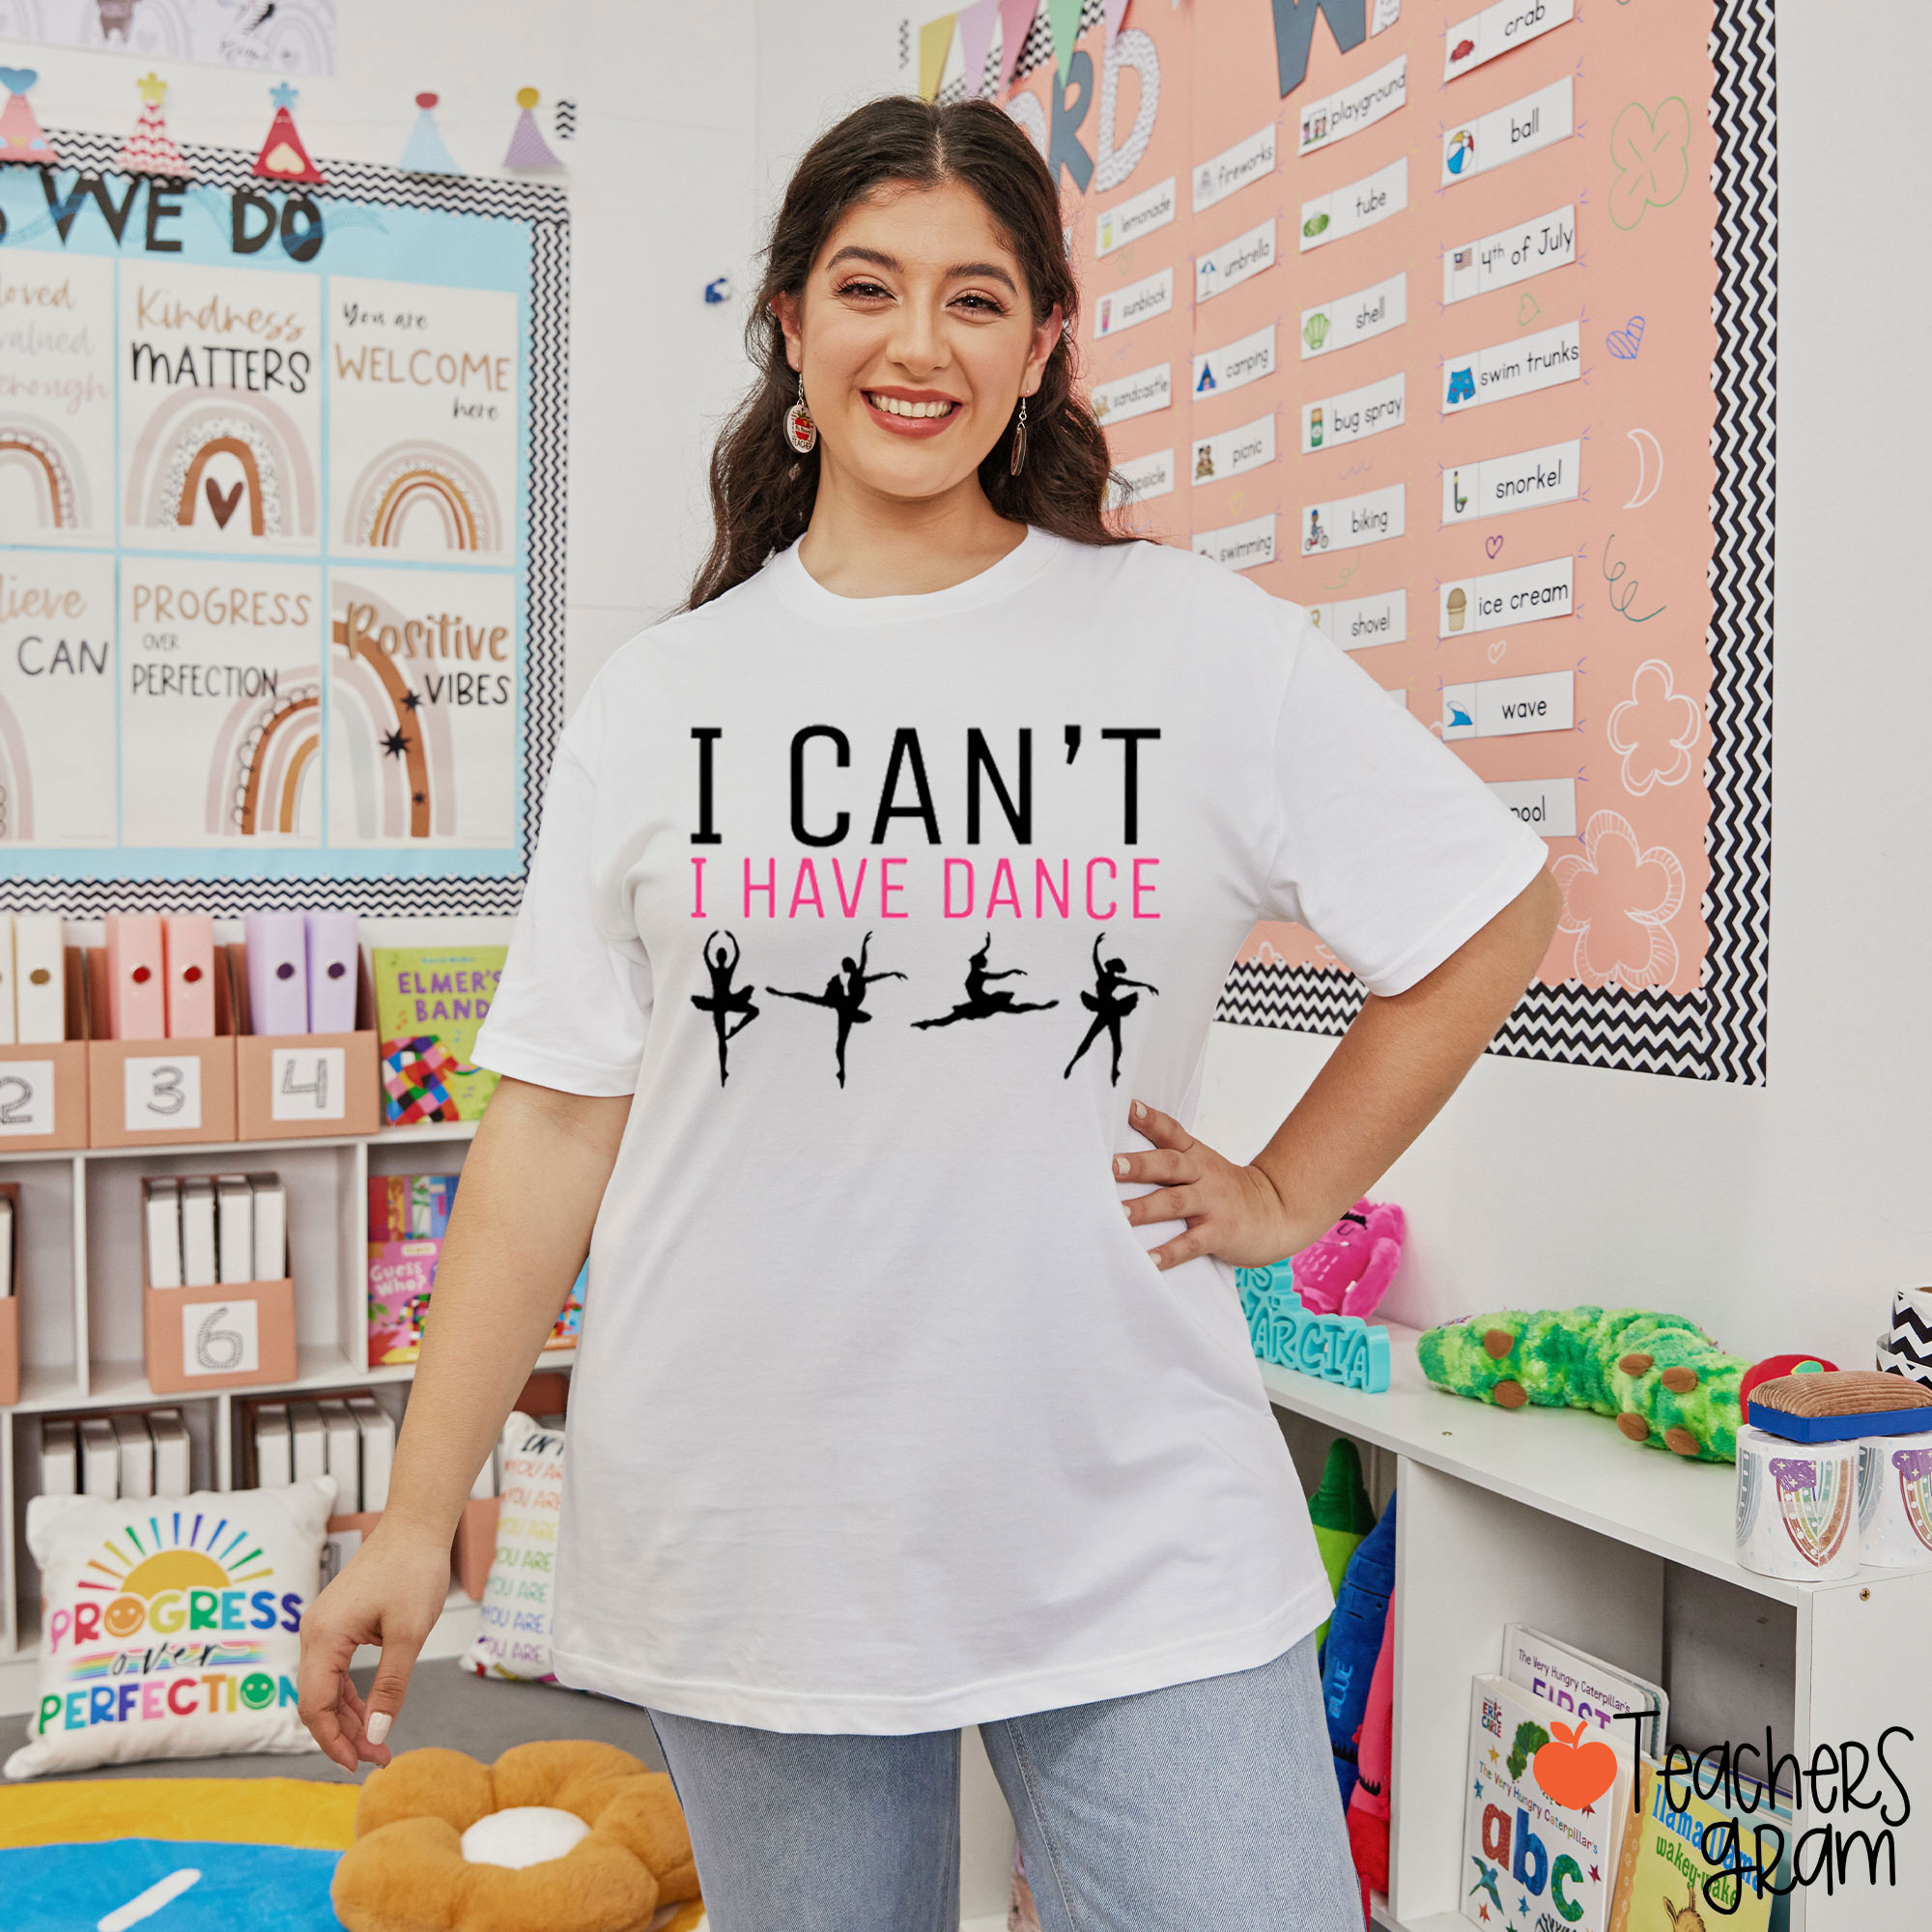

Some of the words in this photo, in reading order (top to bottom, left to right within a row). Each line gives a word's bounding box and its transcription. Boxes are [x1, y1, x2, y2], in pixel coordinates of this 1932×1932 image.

[1504, 3, 1546, 37] crab
[1331, 64, 1406, 126] playground
[1511, 107, 1540, 144] ball
[1218, 143, 1273, 188] fireworks
[39, 168, 183, 253] WE
[232, 191, 324, 263] DO
[1122, 193, 1172, 234] lemonade
[1356, 188, 1386, 217] tube
[1224, 240, 1269, 278] umbrella
[1511, 236, 1530, 267] of
[1537, 222, 1574, 257] July
[136, 285, 305, 342] Kindness
[343, 301, 385, 327] You
[394, 312, 429, 331] are
[1122, 283, 1166, 319] sunblock
[1356, 297, 1386, 329] shell
[131, 342, 310, 393] MATTERS
[334, 343, 511, 392] WELCOME
[1226, 349, 1269, 379] camping
[1480, 361, 1520, 386] swim
[1526, 339, 1579, 375] trunks
[453, 396, 499, 420] here
[1334, 410, 1360, 434] bug
[1365, 397, 1403, 426] spray
[1233, 440, 1263, 466] picnic
[1496, 459, 1563, 499] snorkel
[1351, 509, 1388, 533] biking
[1220, 533, 1272, 563] swimming
[132, 584, 311, 627] PROGRESS
[1479, 595, 1503, 616] ice
[1510, 582, 1569, 609] cream
[347, 601, 509, 662] Positive
[1351, 607, 1391, 637] shovel
[17, 636, 108, 675] CAN
[142, 633, 179, 652] OVER
[131, 664, 278, 698] PERFECTION
[424, 672, 511, 706] VIBES
[1502, 697, 1548, 720] wave
[691, 727, 723, 844] I
[790, 724, 1161, 847] CAN'T
[691, 858, 707, 919] I
[743, 857, 909, 919] HAVE
[943, 856, 1161, 921] DANCE
[415, 1000, 491, 1022] BAND
[0, 1075, 33, 1125] 2
[147, 1065, 185, 1115] 3
[282, 1058, 327, 1109] 4
[370, 1262, 423, 1283] Guess
[375, 1274, 427, 1297] Who?
[196, 1307, 242, 1370] 6
[1246, 1307, 1371, 1388] ARCIA
[533, 1491, 561, 1511] AR
[497, 1546, 521, 1567] OU
[50, 1590, 302, 1655] PROGRESS
[513, 1610, 546, 1634] ARE
[112, 1641, 226, 1677] over
[1327, 1659, 1352, 1719] BLUE
[1519, 1648, 1532, 1665] The
[1533, 1656, 1549, 1677] Very
[1551, 1666, 1579, 1690] Hungry
[1581, 1680, 1631, 1714] Caterpillar's
[1481, 1715, 1502, 1739] CARLE
[1483, 1701, 1502, 1725] ERIC
[1479, 1761, 1492, 1780] The
[1494, 1775, 1512, 1797] Very
[1513, 1788, 1543, 1819] Hungry
[1545, 1809, 1598, 1855] Caterpillar's
[1482, 1804, 1584, 1922] abc
